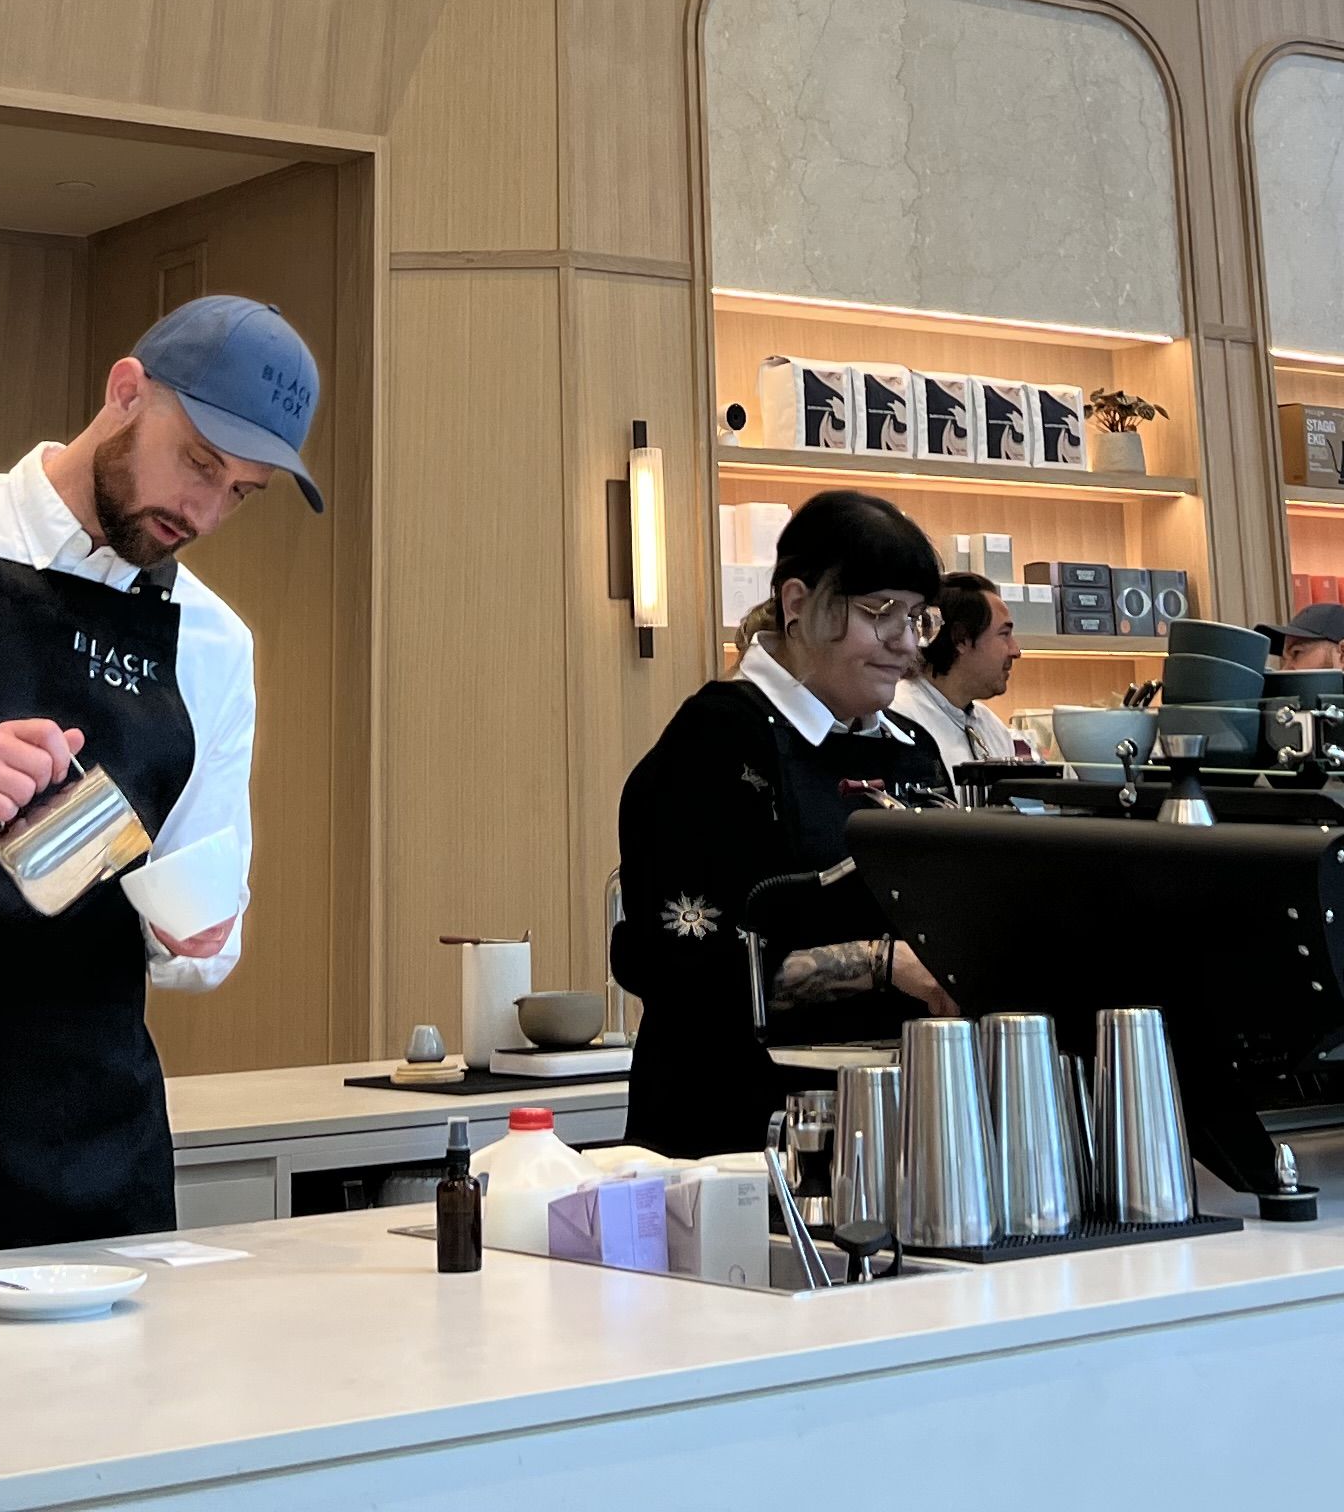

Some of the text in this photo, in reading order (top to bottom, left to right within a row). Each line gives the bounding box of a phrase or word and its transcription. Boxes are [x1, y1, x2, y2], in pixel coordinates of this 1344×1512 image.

[262, 364, 311, 408] BLACK
[271, 388, 303, 419] FOX
[1306, 418, 1336, 434] STAGG
[74, 630, 159, 681] BLACK
[89, 659, 141, 695] FOX
